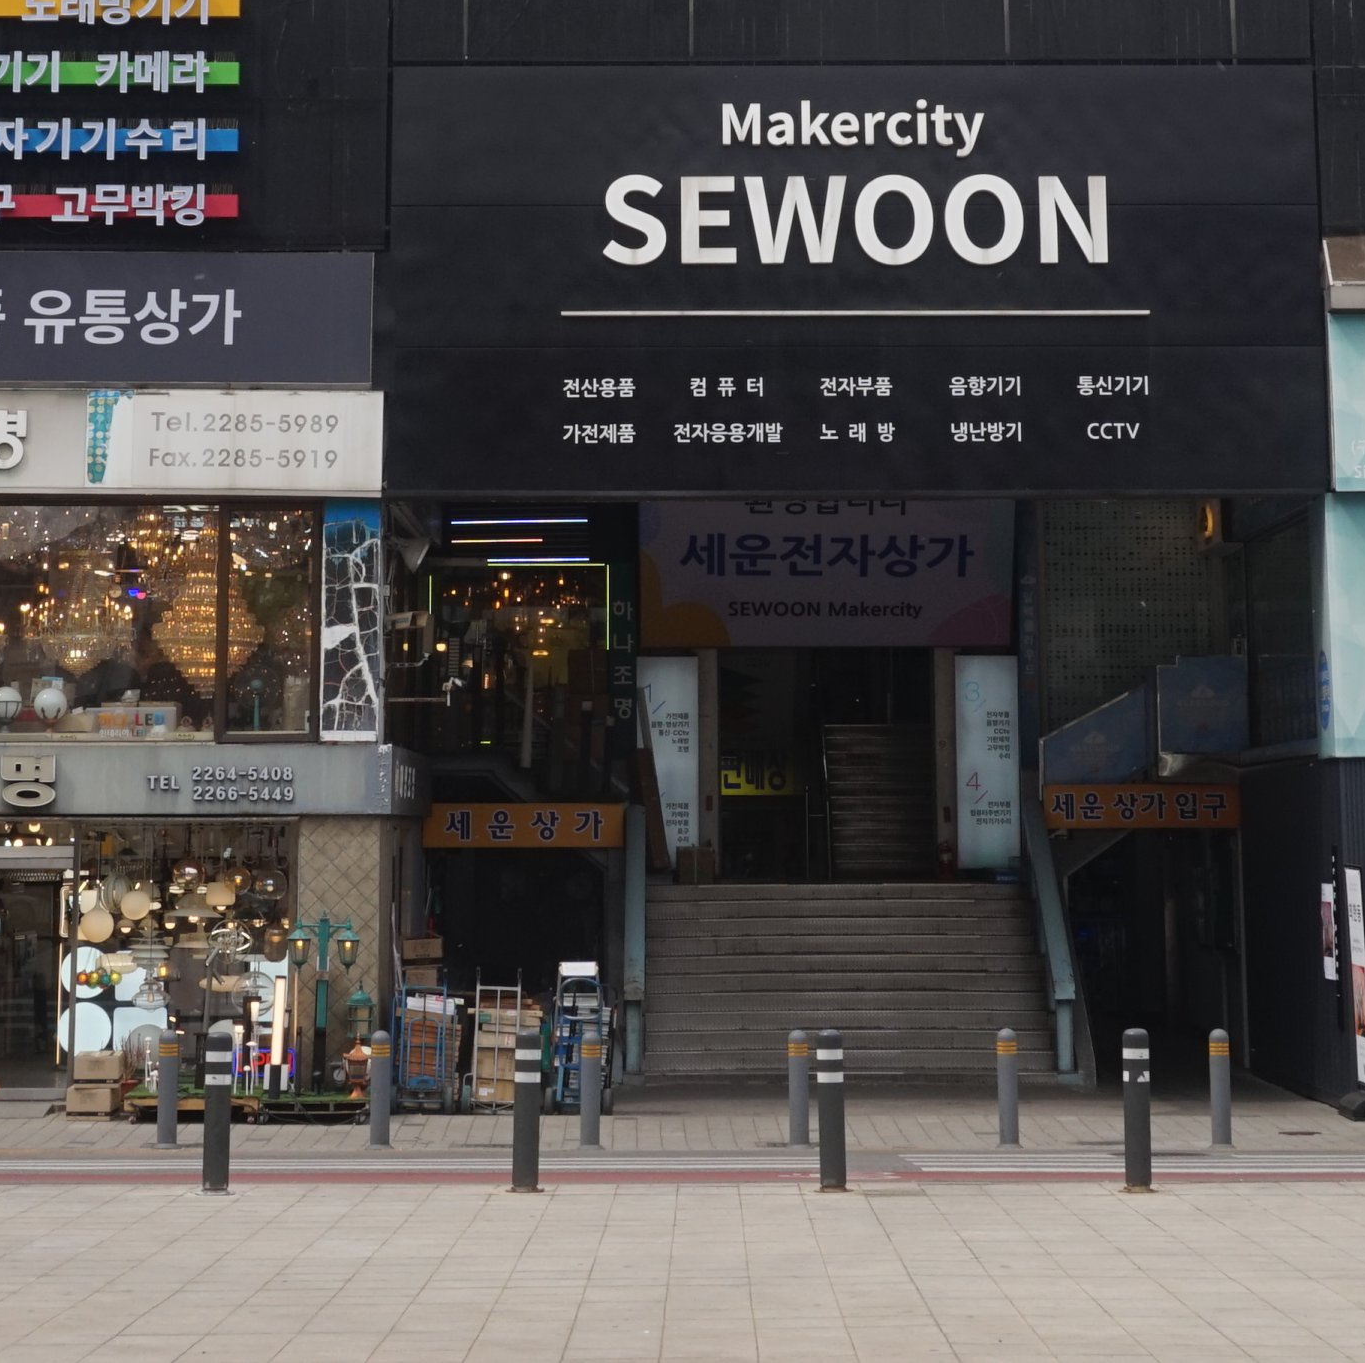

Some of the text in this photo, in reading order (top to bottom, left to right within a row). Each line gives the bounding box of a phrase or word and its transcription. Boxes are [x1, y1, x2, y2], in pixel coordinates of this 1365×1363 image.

[96, 51, 210, 93] 카메라
[721, 99, 984, 157] Makercity
[51, 183, 206, 226] 고무박킹
[602, 174, 1109, 265] SEWOON
[24, 287, 241, 346] 유통상가
[562, 377, 635, 398] 전산용품
[819, 376, 893, 397] 전자부품
[949, 376, 1022, 397] 음향기기
[1077, 375, 1150, 397] 통신기기
[150, 412, 340, 436] Tel.2285-5989
[562, 422, 635, 445] 가전제품
[673, 422, 783, 444] 전자응용개발
[950, 422, 1022, 444] 냉난방기
[1087, 422, 1140, 441] CCTV
[148, 446, 340, 471] Fax.2285-5919
[680, 533, 974, 578] 세운전자상가
[728, 601, 922, 620] SEWOON Makercity
[613, 600, 633, 719] 하나조명
[965, 681, 980, 702] 3
[136, 713, 165, 726] LED
[147, 766, 294, 791] TEL 2264-5408
[966, 772, 981, 791] 4
[192, 786, 295, 802] 2266-5449
[1052, 792, 1227, 821] 세운 상가 입구
